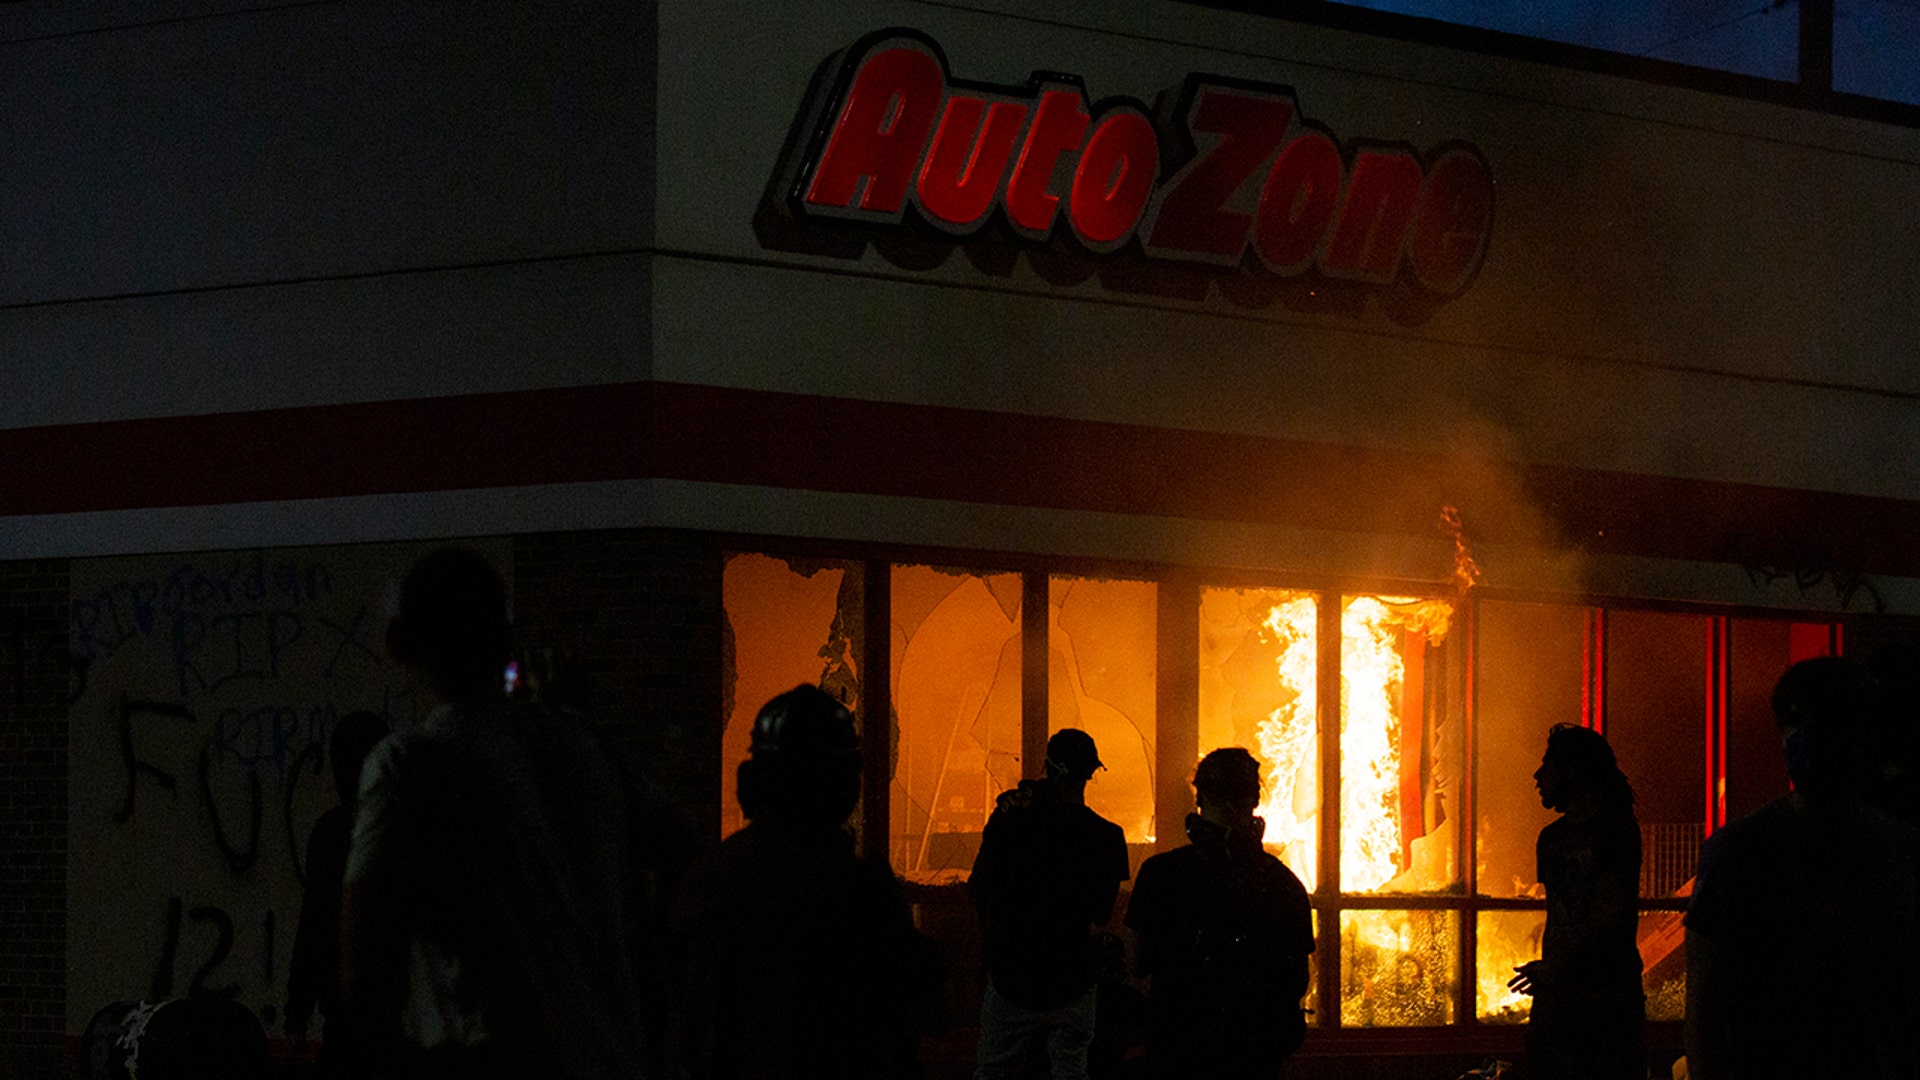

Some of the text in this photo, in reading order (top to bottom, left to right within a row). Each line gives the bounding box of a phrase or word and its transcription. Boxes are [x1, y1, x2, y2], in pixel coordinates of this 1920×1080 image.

[805, 43, 1488, 297] AutoZone
[170, 609, 303, 696] RIP
[113, 693, 325, 884] FUC
